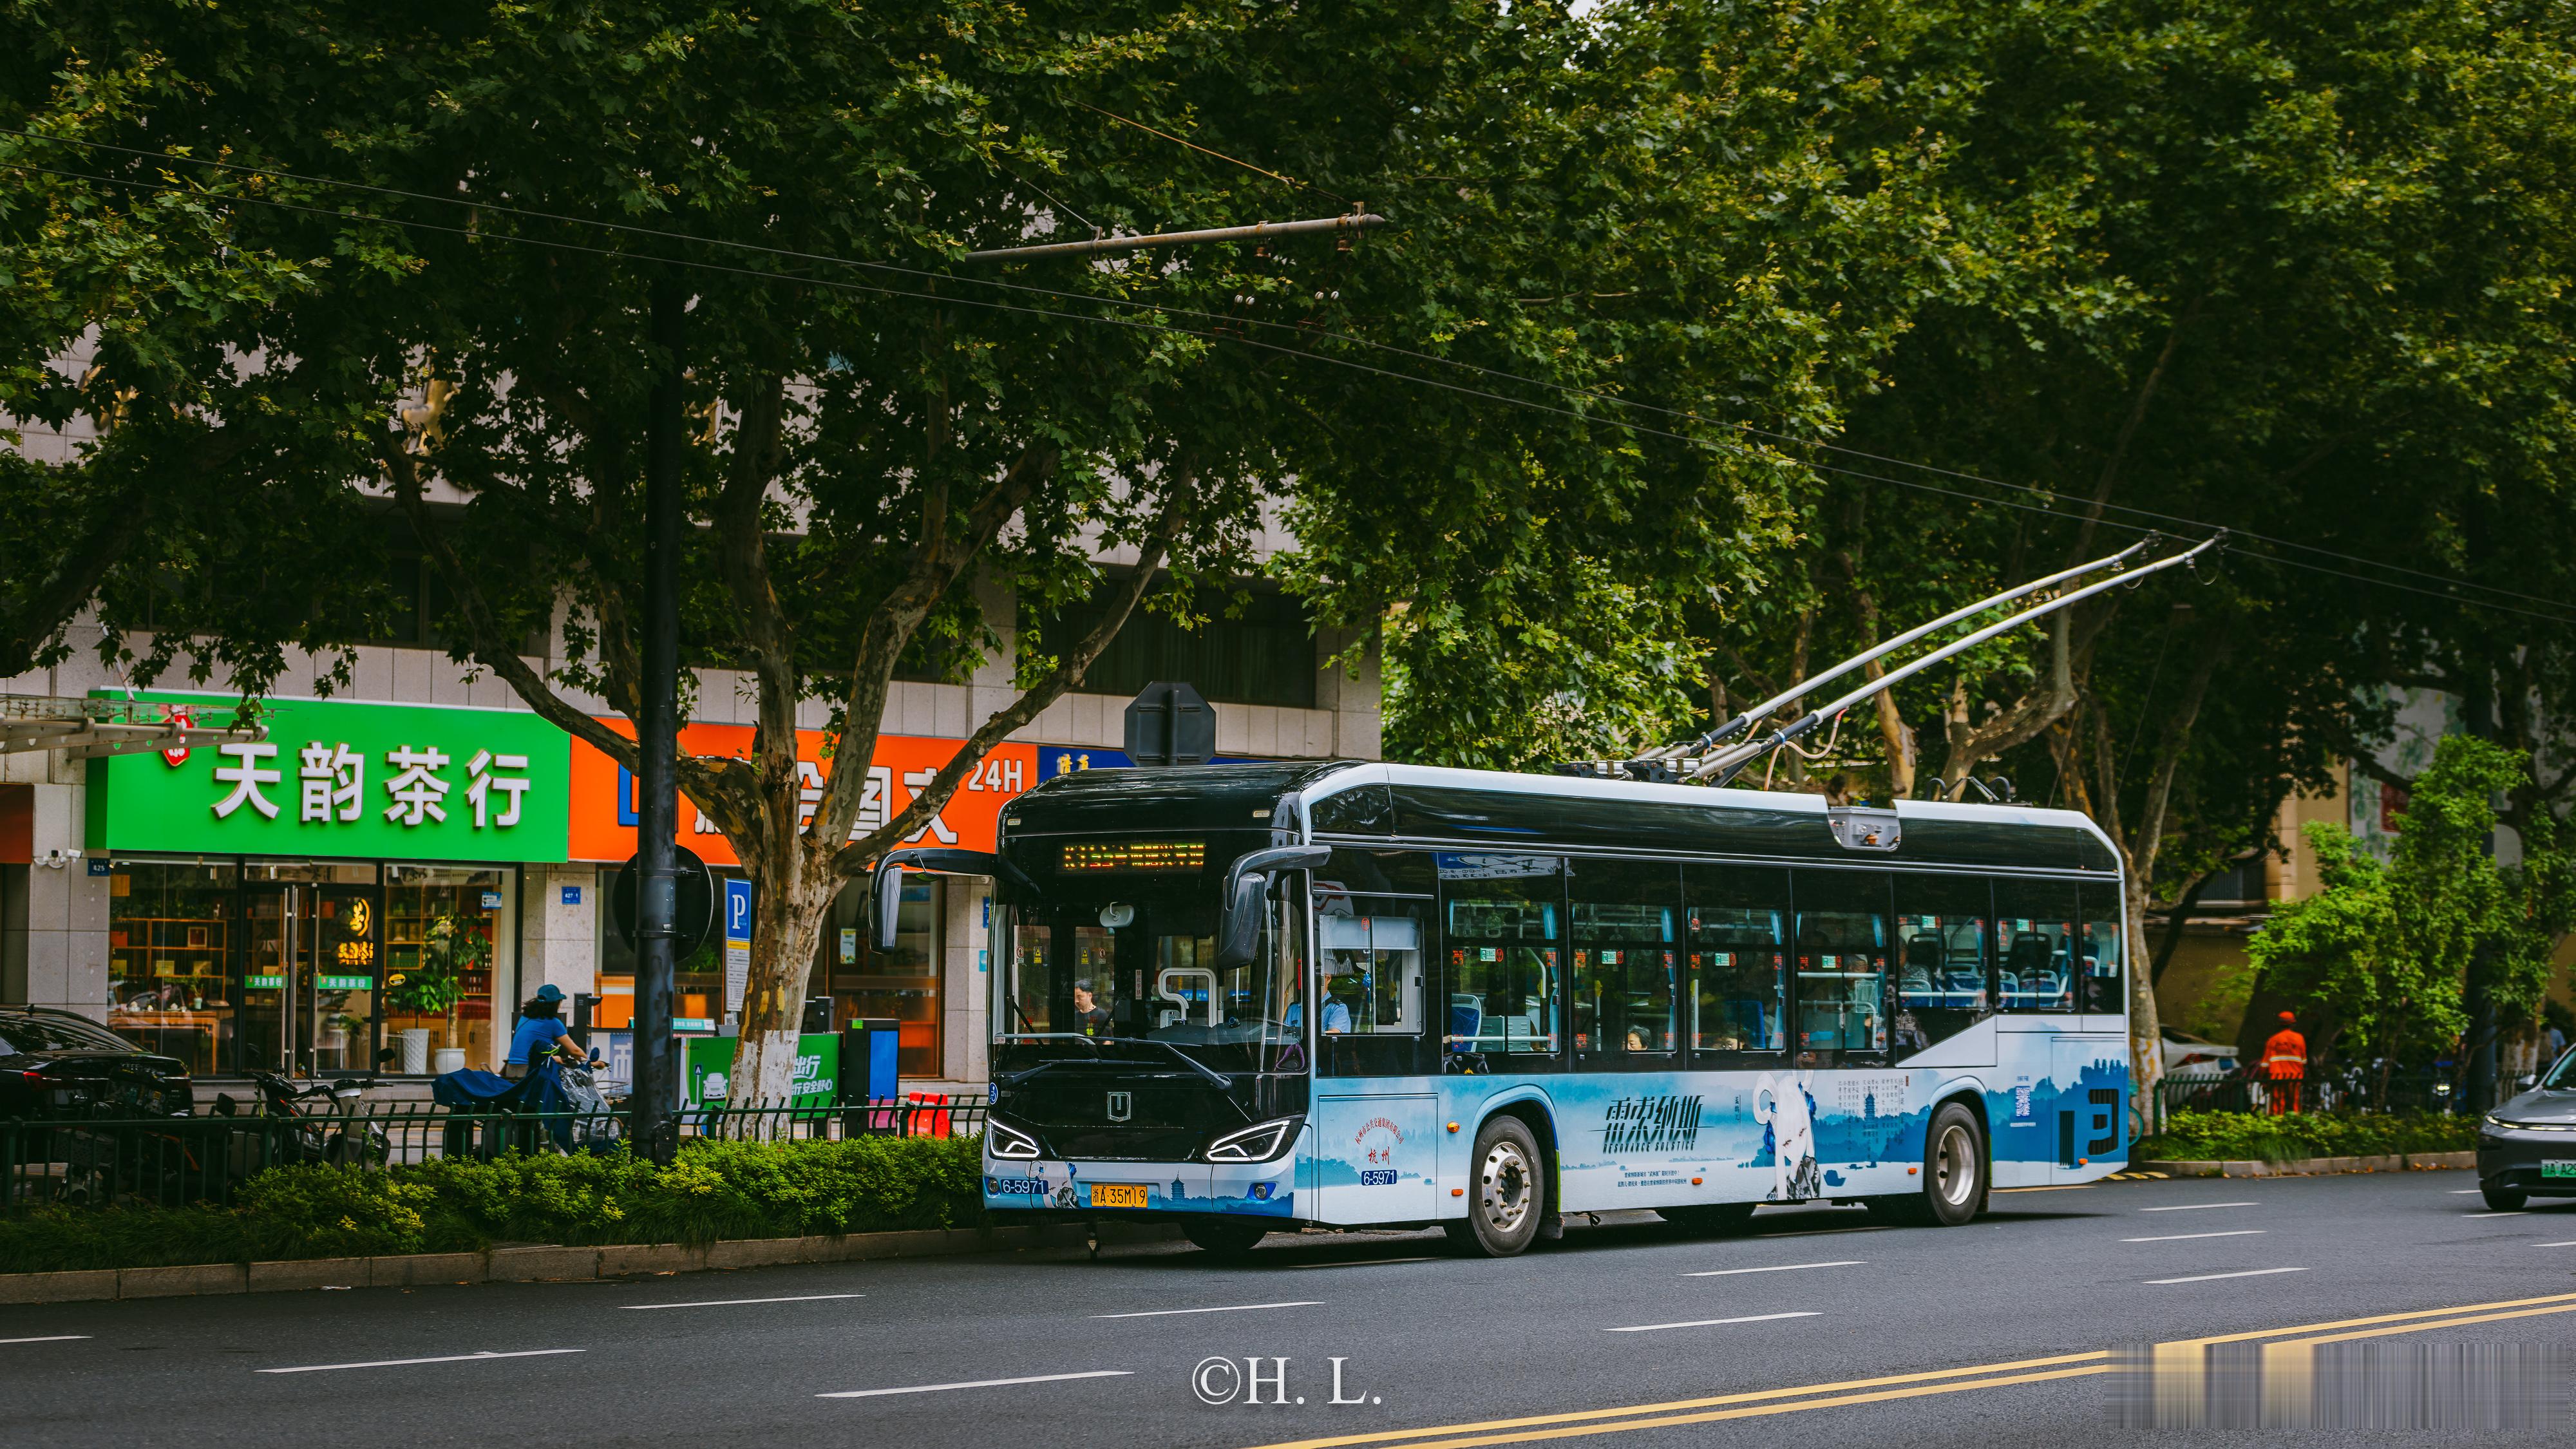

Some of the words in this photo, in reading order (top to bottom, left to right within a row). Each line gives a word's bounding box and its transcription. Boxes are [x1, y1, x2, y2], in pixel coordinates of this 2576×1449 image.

[211, 741, 530, 828] 天韵茶行
[968, 759, 1023, 793] 24H
[732, 894, 746, 929] P
[1354, 1117, 1405, 1145] 杭州市公共交通集团有限公司
[1368, 1146, 1390, 1166] 杭州
[1654, 1141, 1696, 1152] SOLSTICE
[1002, 1179, 1045, 1194] 6-5971
[1363, 1171, 1395, 1186] 6-5971
